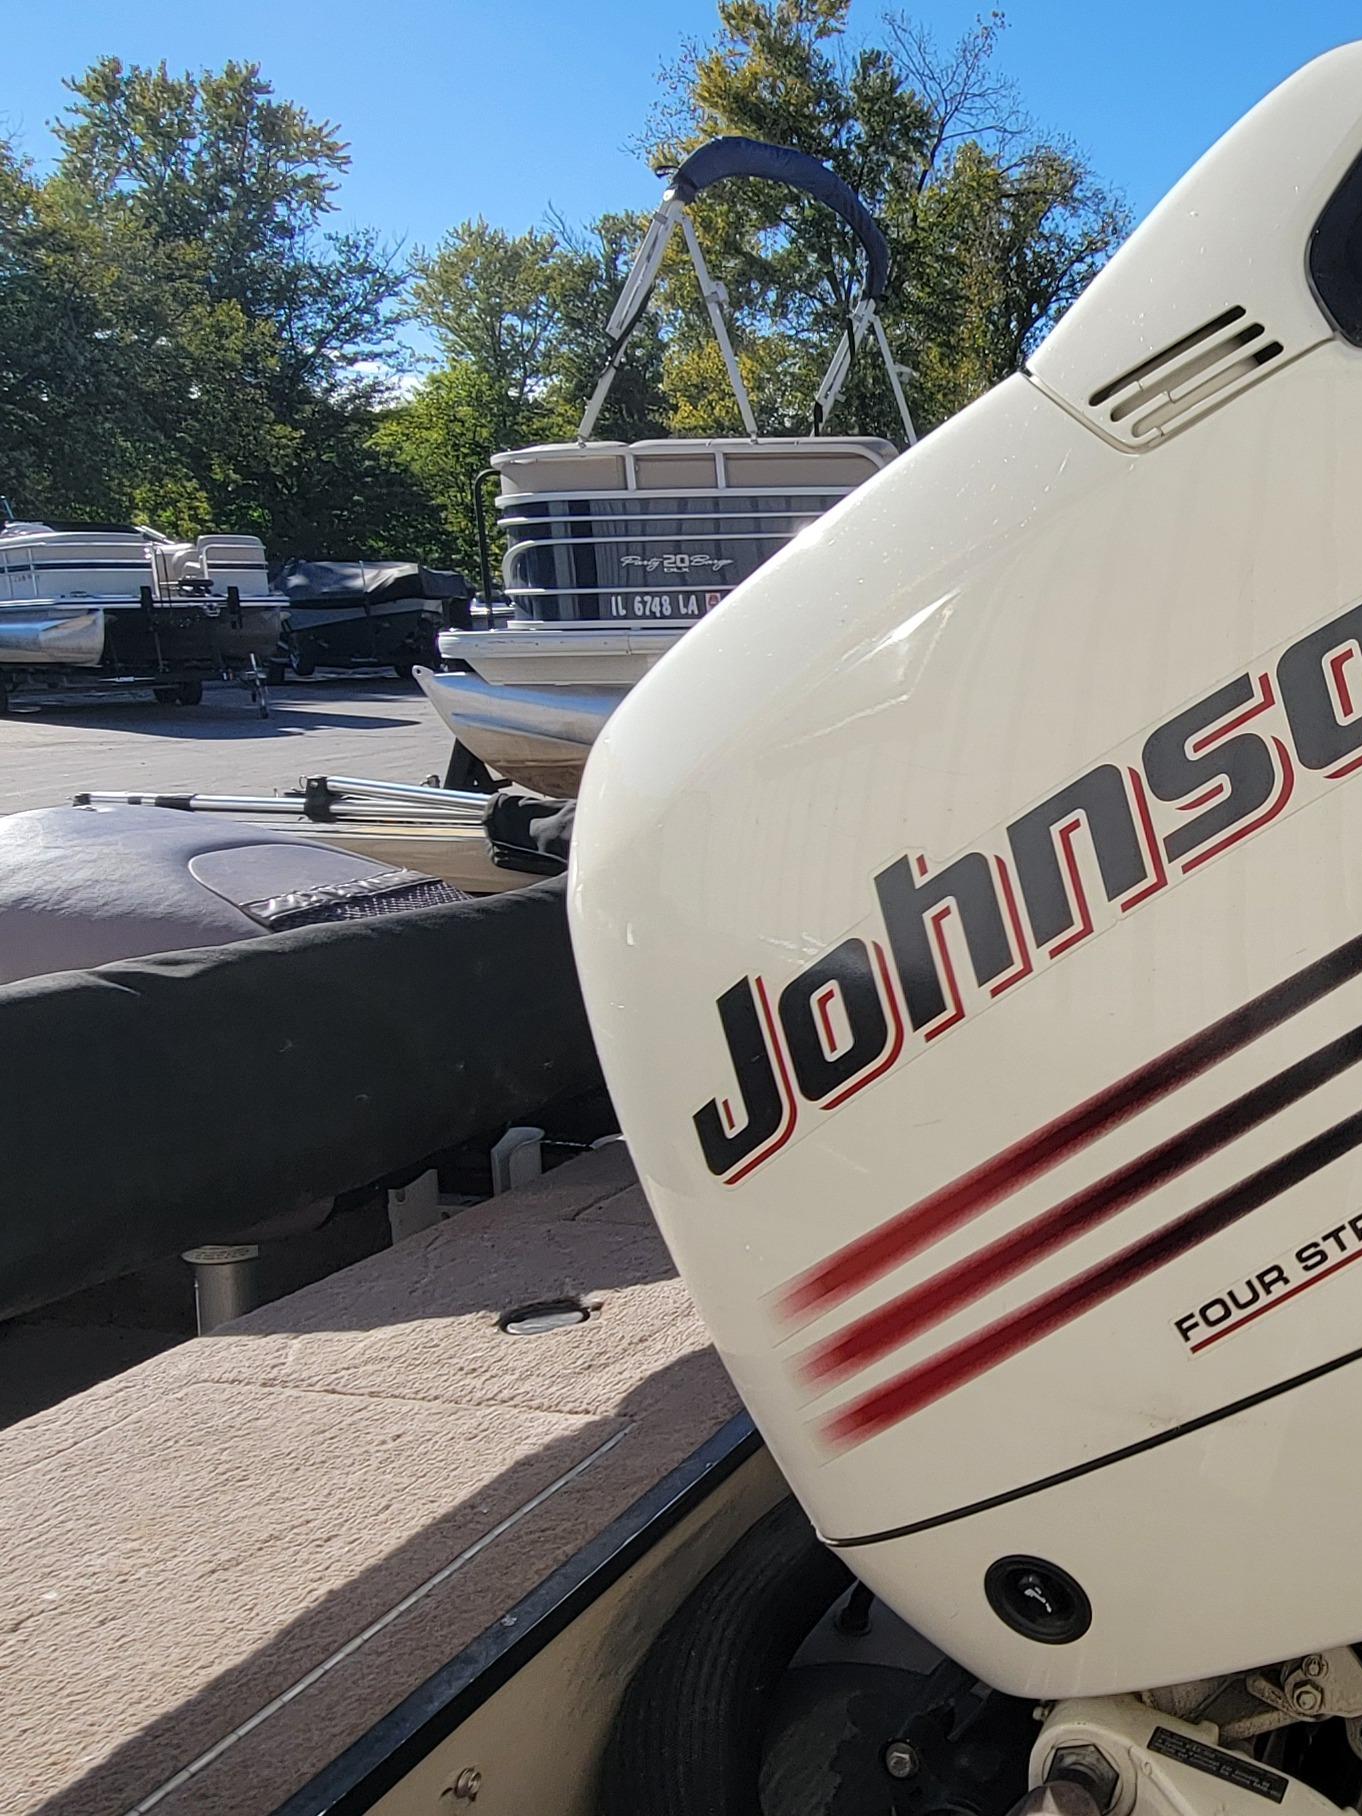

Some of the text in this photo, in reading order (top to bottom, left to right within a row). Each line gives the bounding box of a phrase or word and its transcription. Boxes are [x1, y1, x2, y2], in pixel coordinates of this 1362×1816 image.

[620, 555, 663, 572] Party
[663, 554, 689, 567] 20
[611, 594, 699, 617] IL 6748 LA
[1174, 1264, 1290, 1343] FOUR
